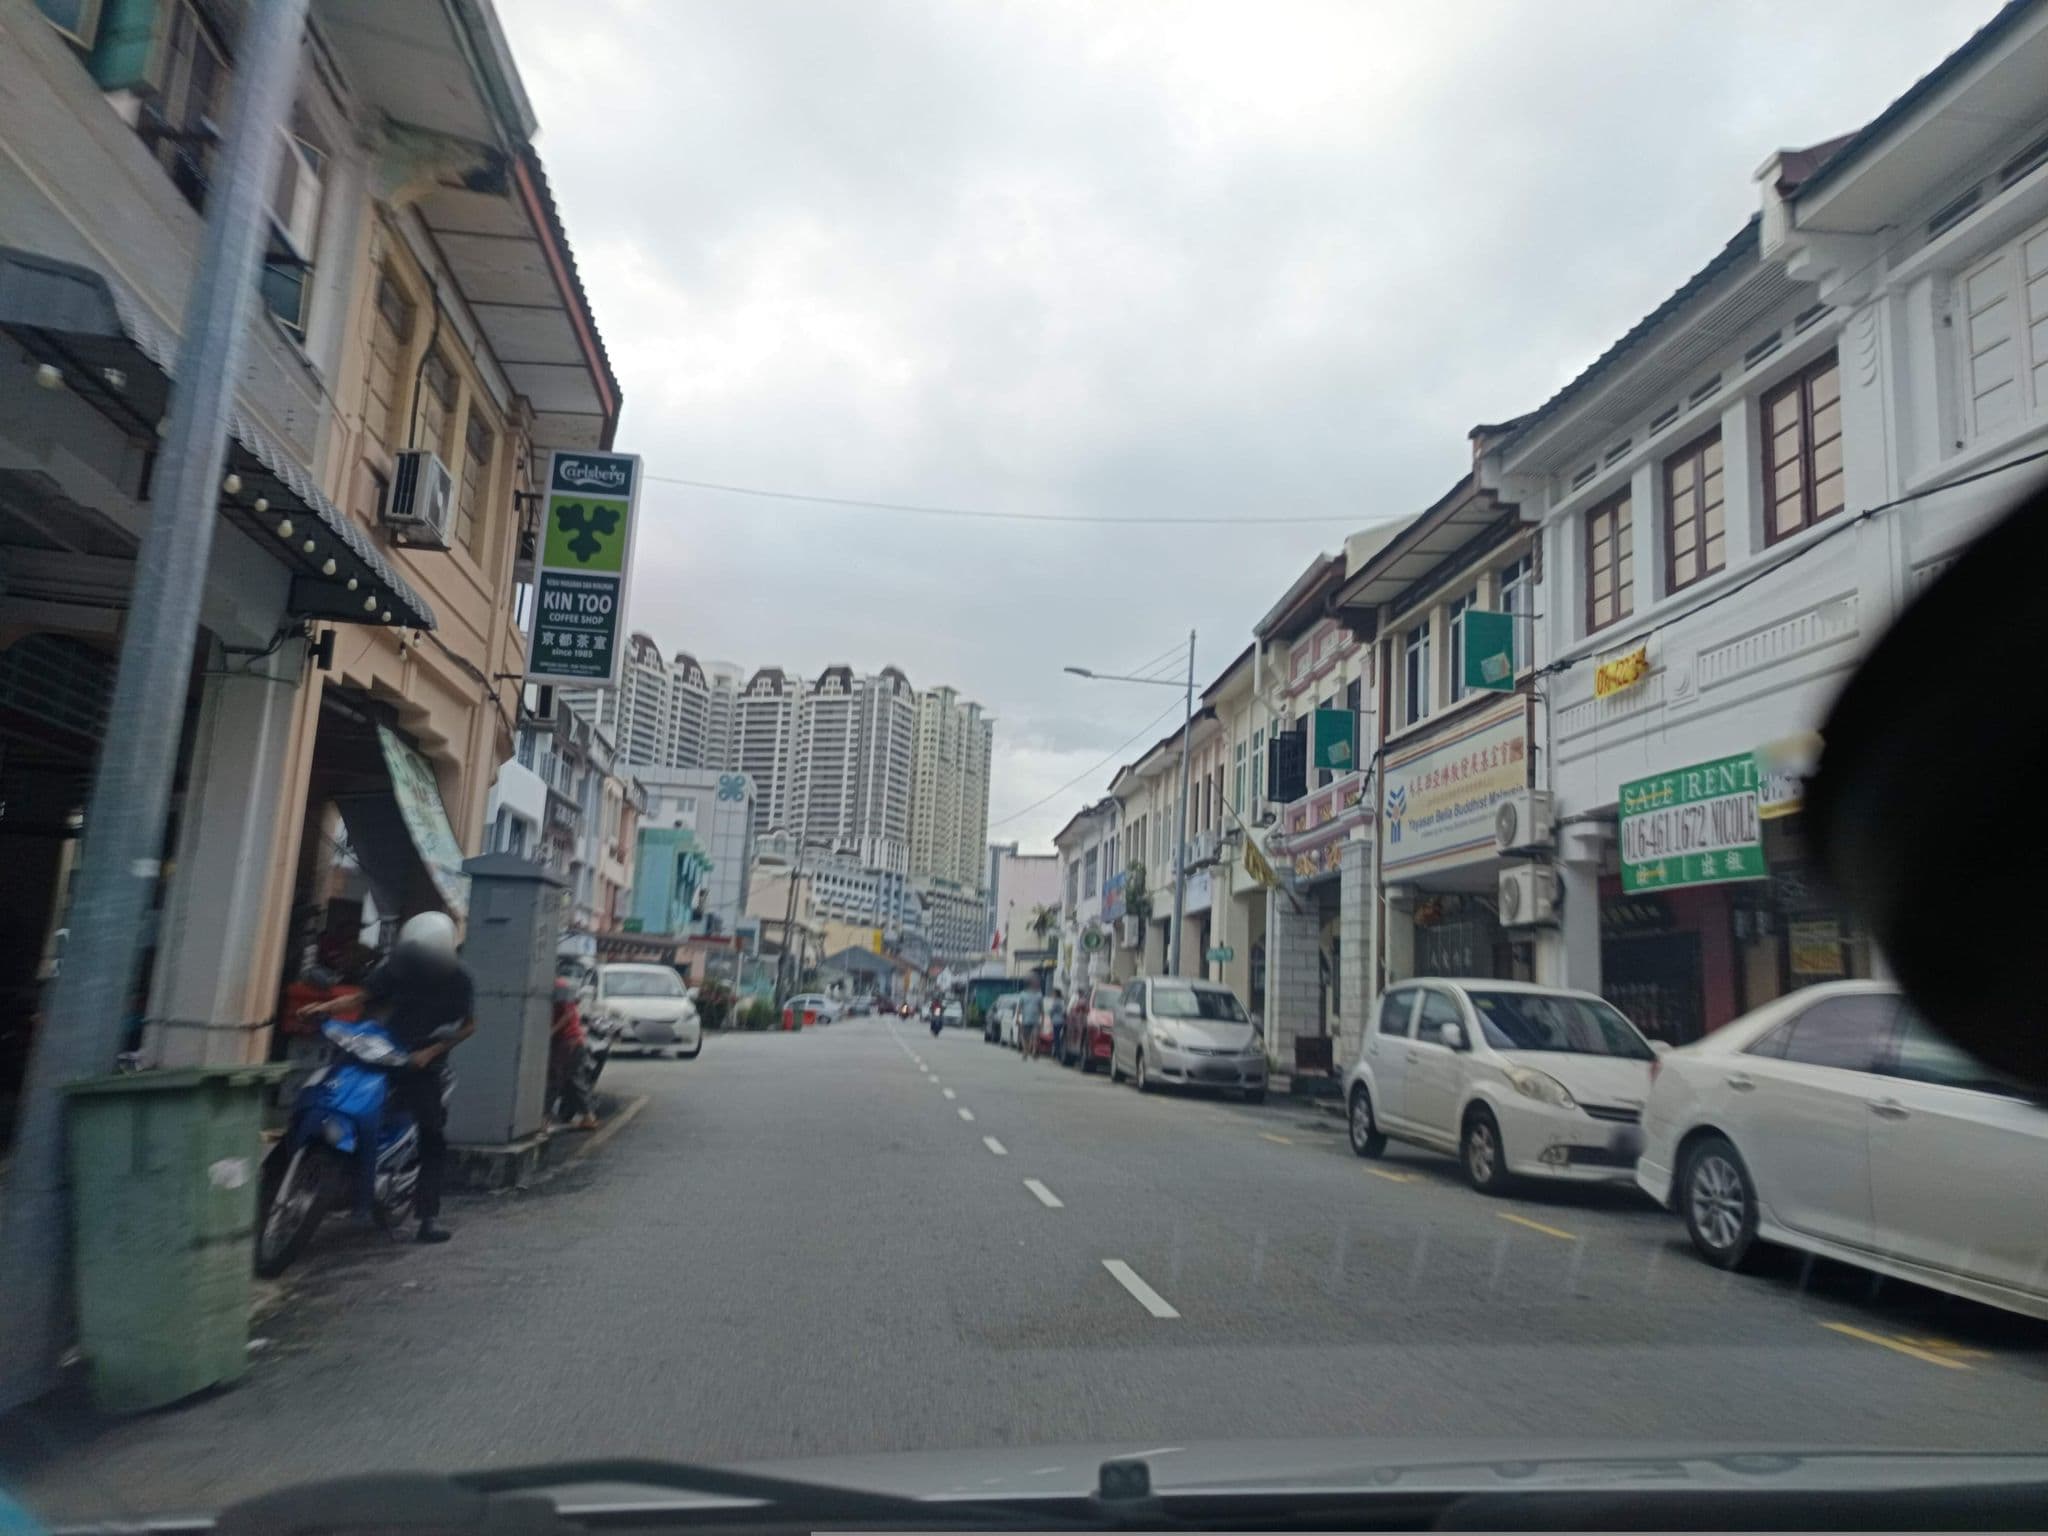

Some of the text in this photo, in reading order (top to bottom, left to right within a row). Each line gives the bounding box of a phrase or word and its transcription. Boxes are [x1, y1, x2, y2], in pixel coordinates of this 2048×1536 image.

[560, 461, 625, 488] Carlsberg
[543, 591, 612, 614] KIN TOO
[549, 612, 604, 625] COFFEE SHOP
[552, 649, 572, 657] since
[1624, 779, 1674, 814] SALE
[1687, 760, 1755, 798] RENT
[1453, 795, 1488, 817] Buddhist
[1710, 795, 1756, 845] NICOLE
